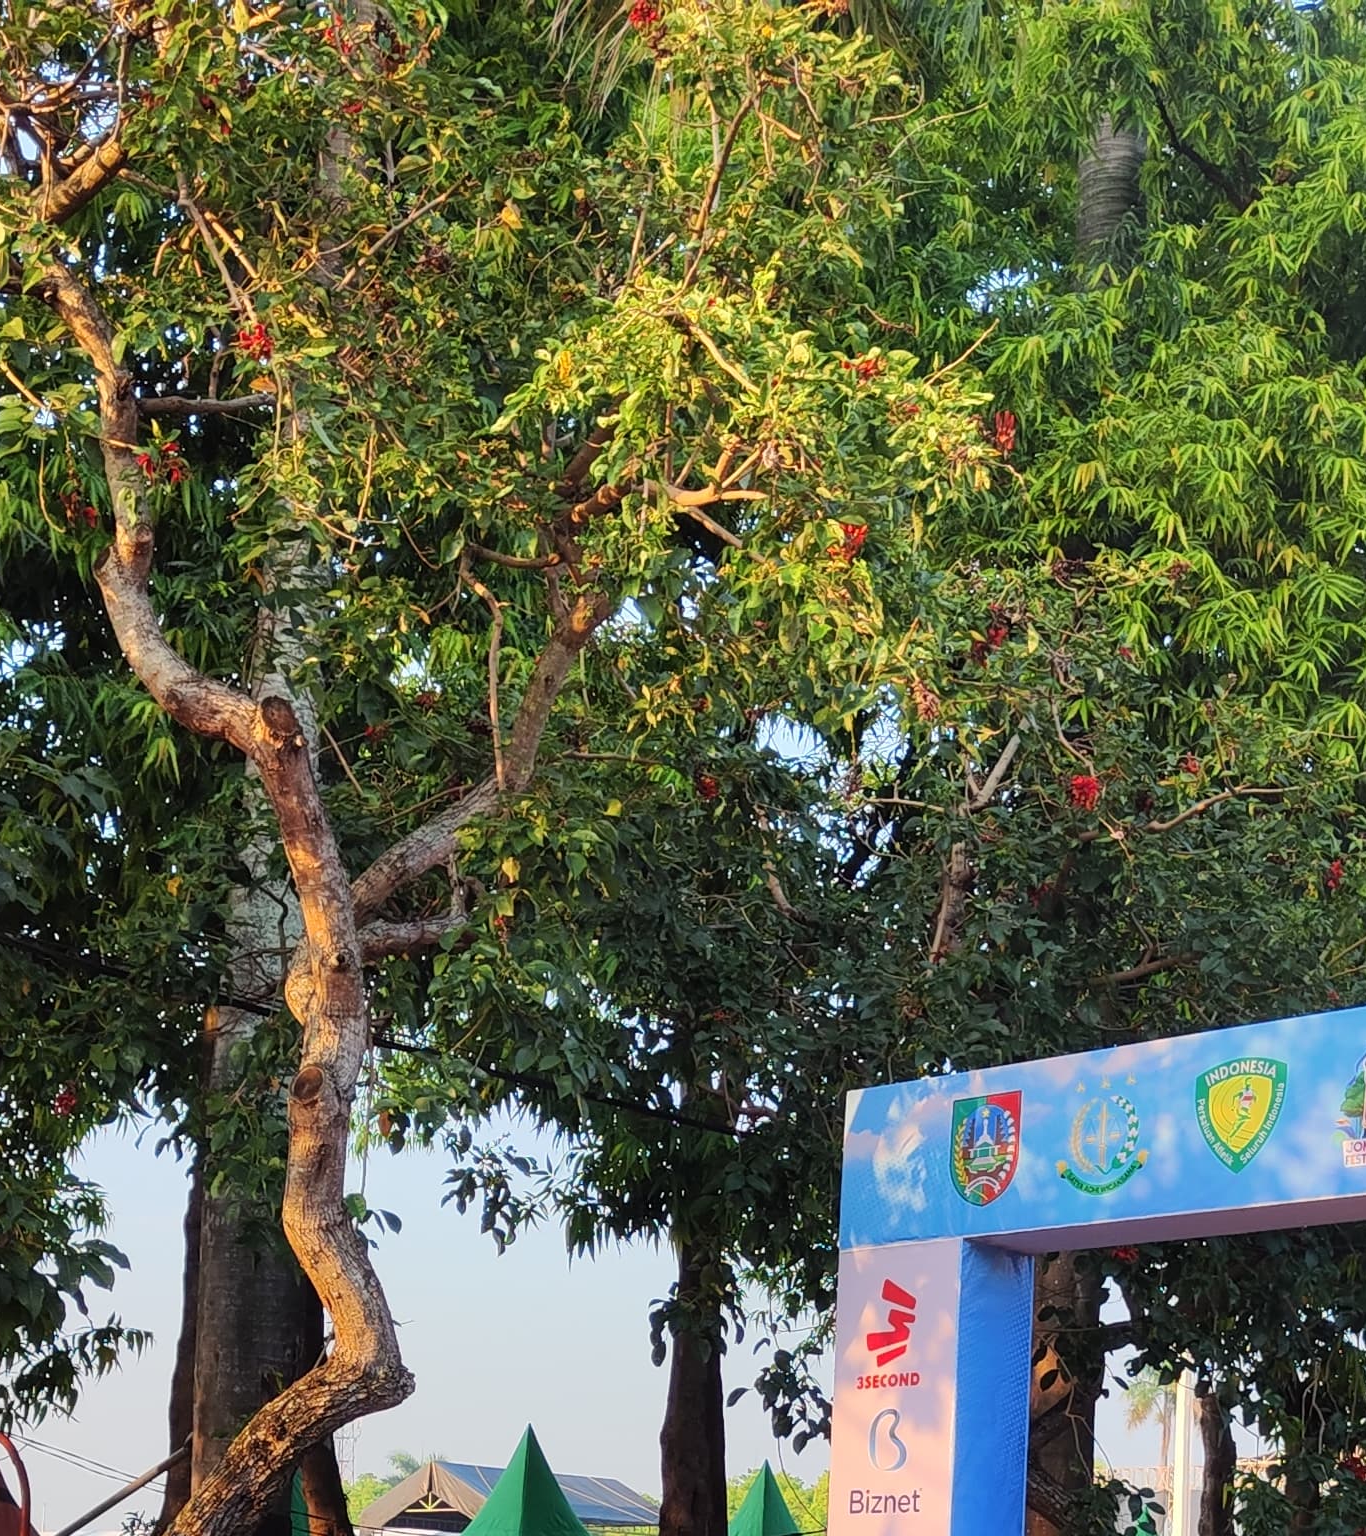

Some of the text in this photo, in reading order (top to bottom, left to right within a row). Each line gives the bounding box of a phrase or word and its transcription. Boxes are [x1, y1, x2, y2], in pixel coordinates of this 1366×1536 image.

[1204, 1060, 1276, 1087] INDONESIA
[1196, 1098, 1215, 1143] Persatuan
[1239, 1082, 1285, 1164] Seluruh Indonesia
[1345, 1153, 1366, 1166] FEST
[857, 1372, 920, 1390] 3SECOND
[849, 1489, 921, 1514] Biznet
